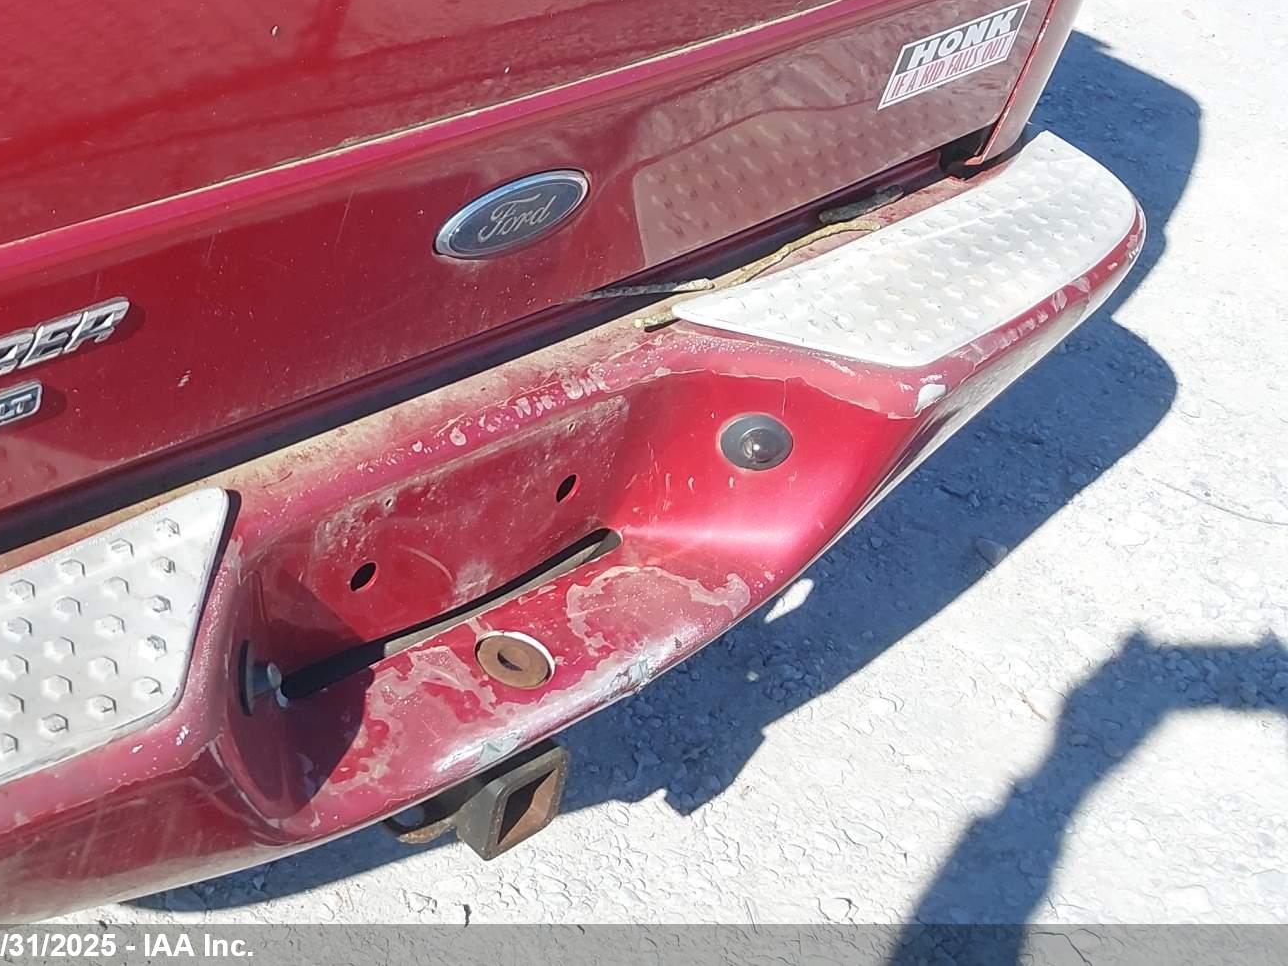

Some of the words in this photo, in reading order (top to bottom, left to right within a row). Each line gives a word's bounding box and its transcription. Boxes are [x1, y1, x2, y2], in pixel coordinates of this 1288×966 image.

[906, 8, 1018, 70] HONK
[919, 60, 944, 87] KID
[945, 46, 983, 77] FALLS
[981, 35, 1012, 62] OUT
[478, 193, 557, 244] Ford
